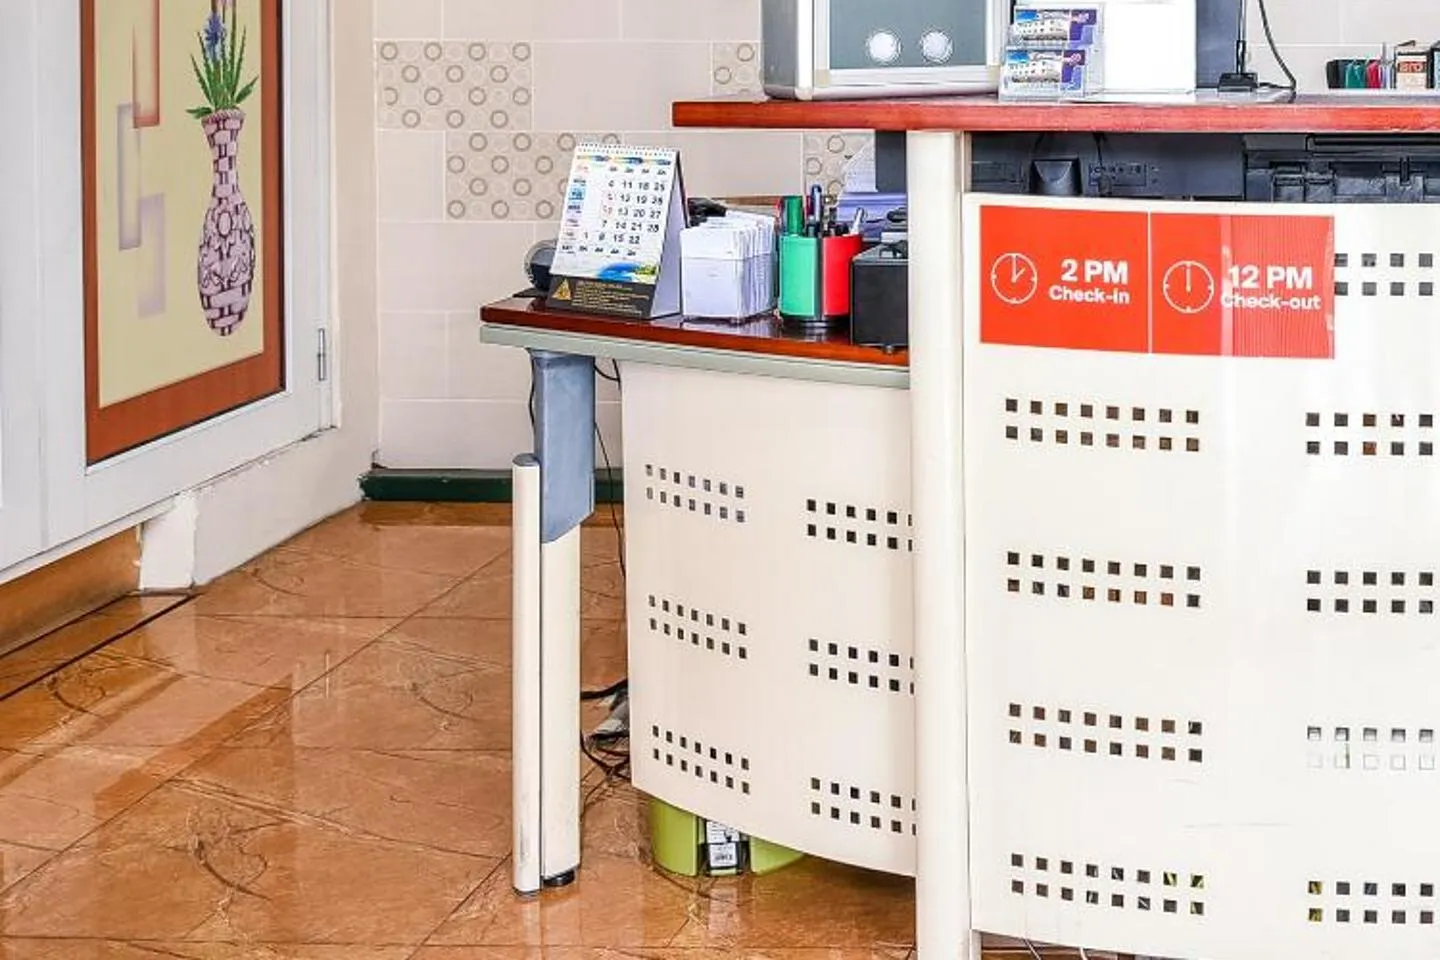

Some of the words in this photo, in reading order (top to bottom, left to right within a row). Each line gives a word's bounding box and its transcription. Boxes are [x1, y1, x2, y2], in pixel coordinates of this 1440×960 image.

[1061, 258, 1079, 282] 2
[1084, 259, 1128, 285] PM
[1228, 264, 1260, 289] 12
[1267, 265, 1313, 290] PM
[1048, 284, 1130, 304] Check-in
[1221, 291, 1322, 310] Check-out
